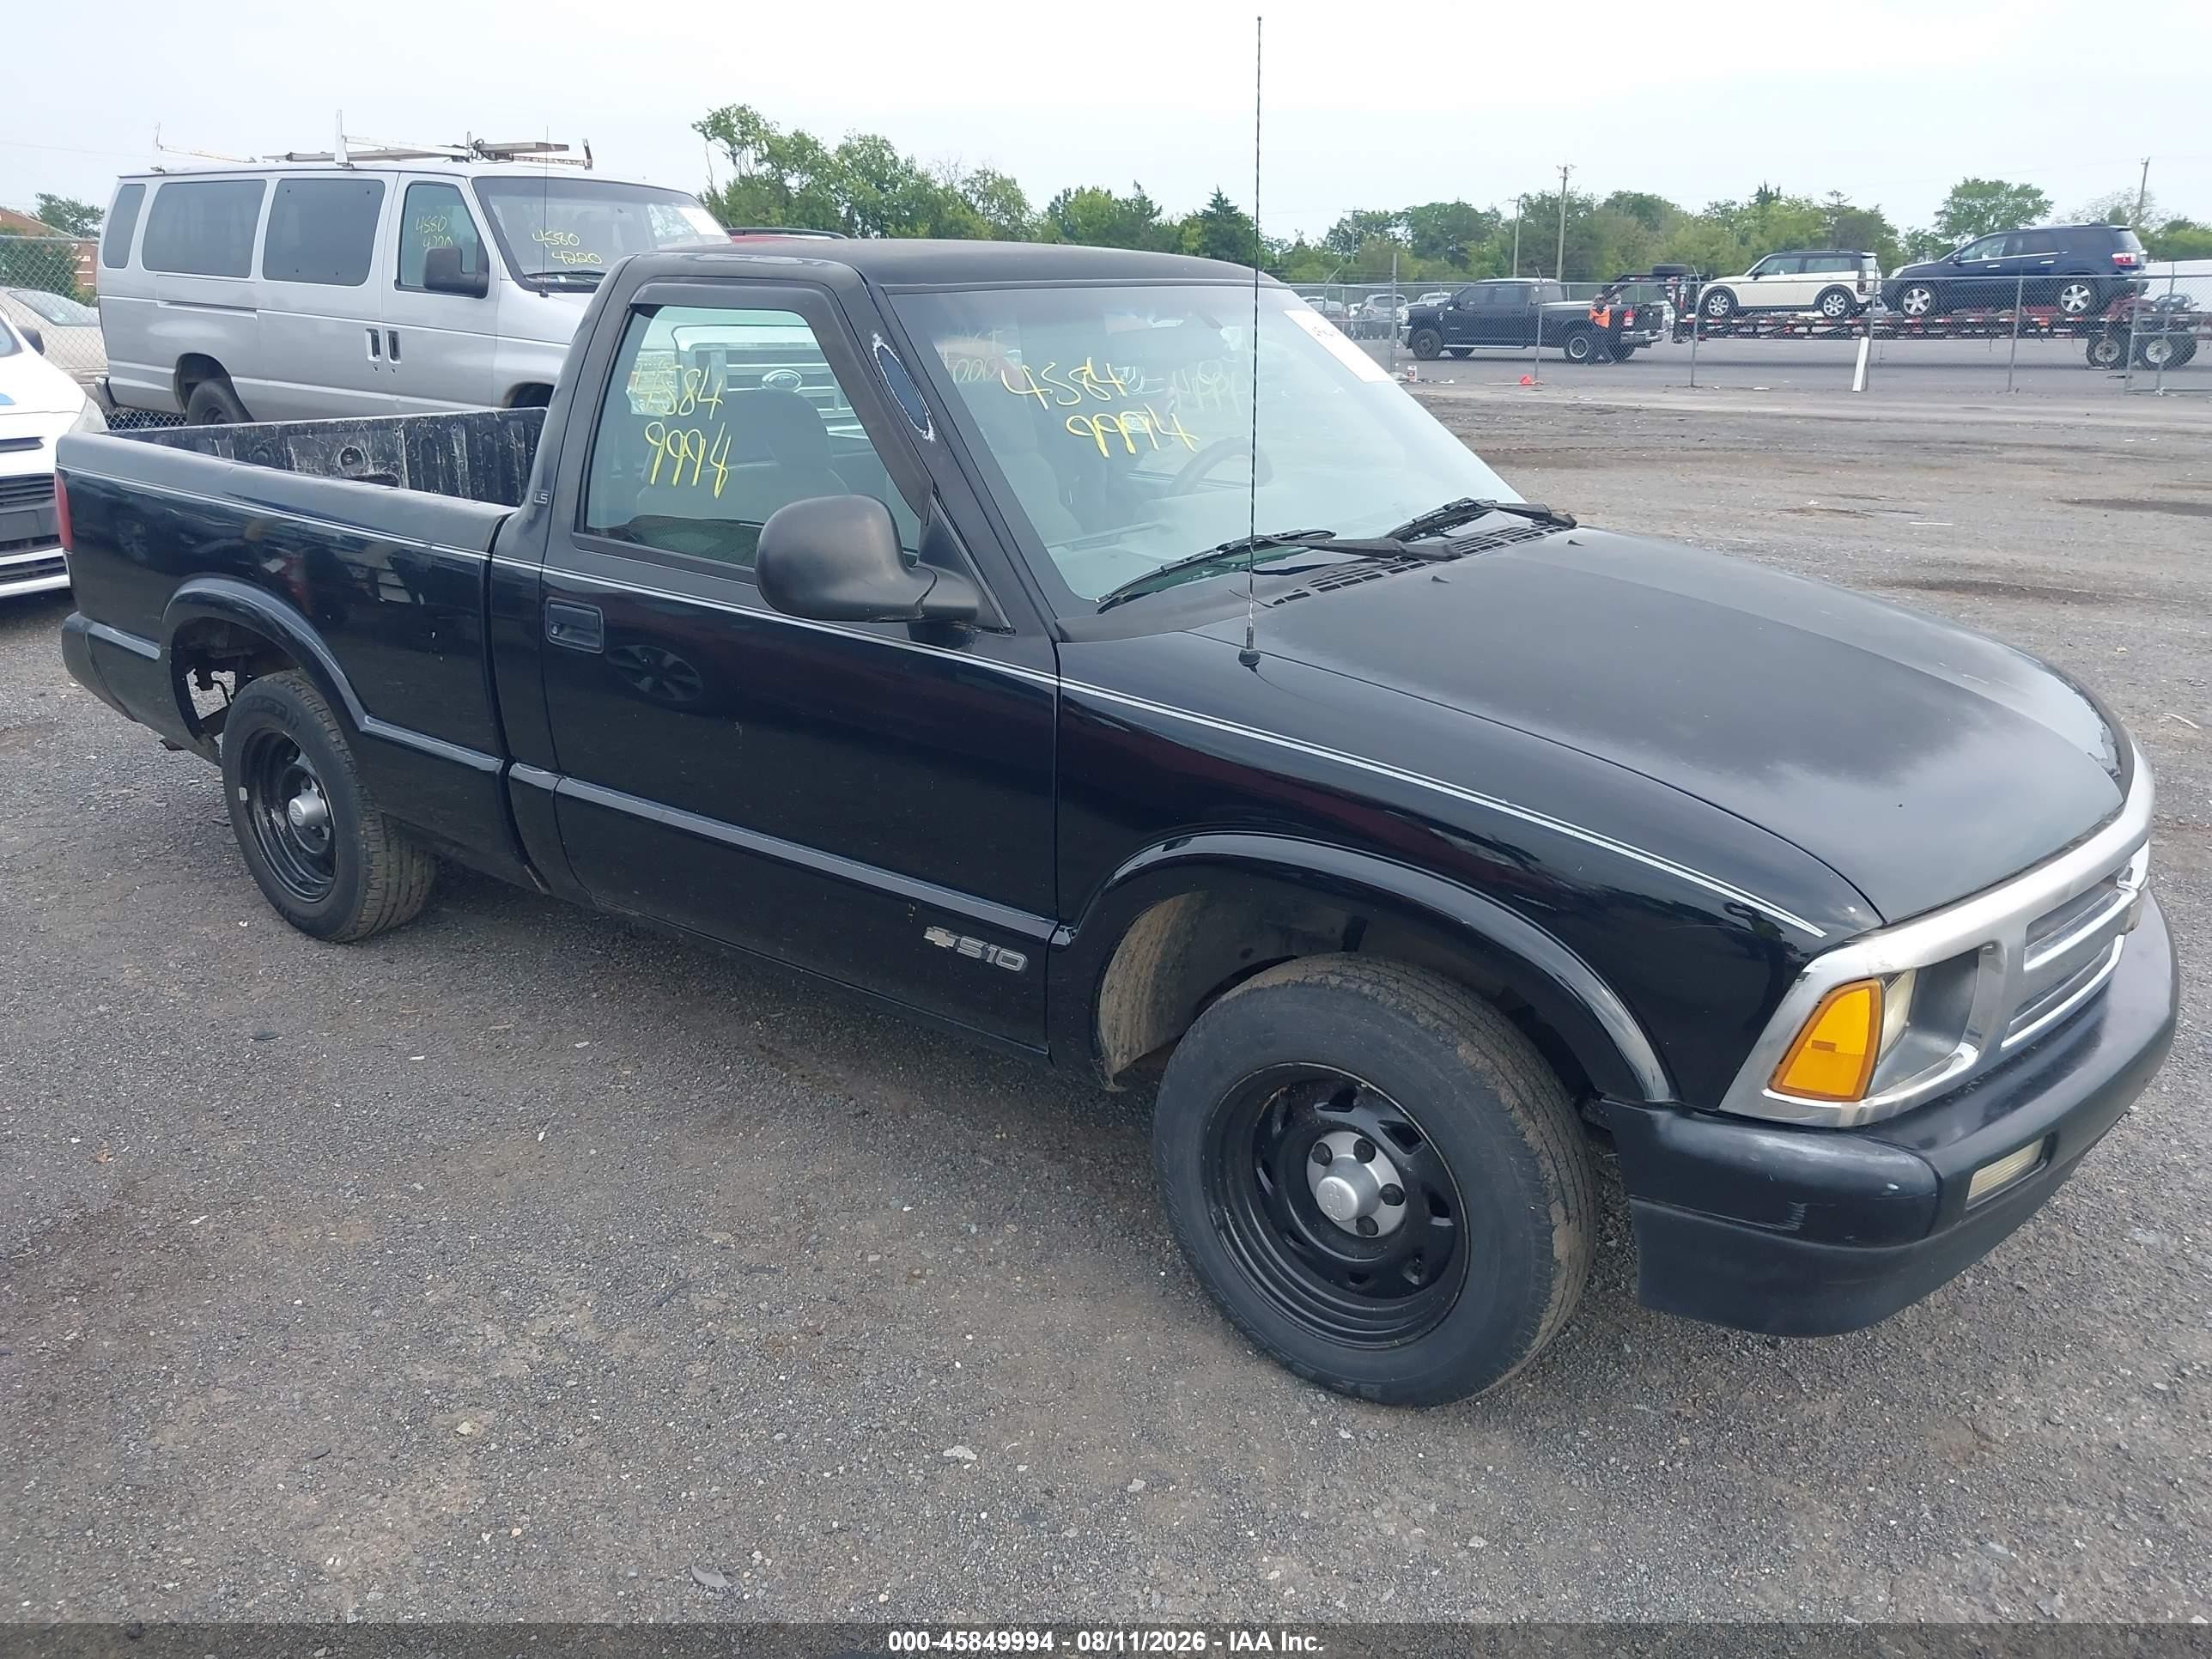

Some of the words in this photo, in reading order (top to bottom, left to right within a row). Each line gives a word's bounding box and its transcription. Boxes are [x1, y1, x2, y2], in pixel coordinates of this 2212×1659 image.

[532, 229, 580, 248] 4580
[551, 251, 603, 265] 4220
[635, 360, 724, 420] 4584
[1000, 356, 1127, 410] 4584
[1066, 403, 1200, 459] 9994
[645, 421, 731, 499] 9994
[534, 492, 549, 504] LS
[957, 936, 1028, 971] S10
